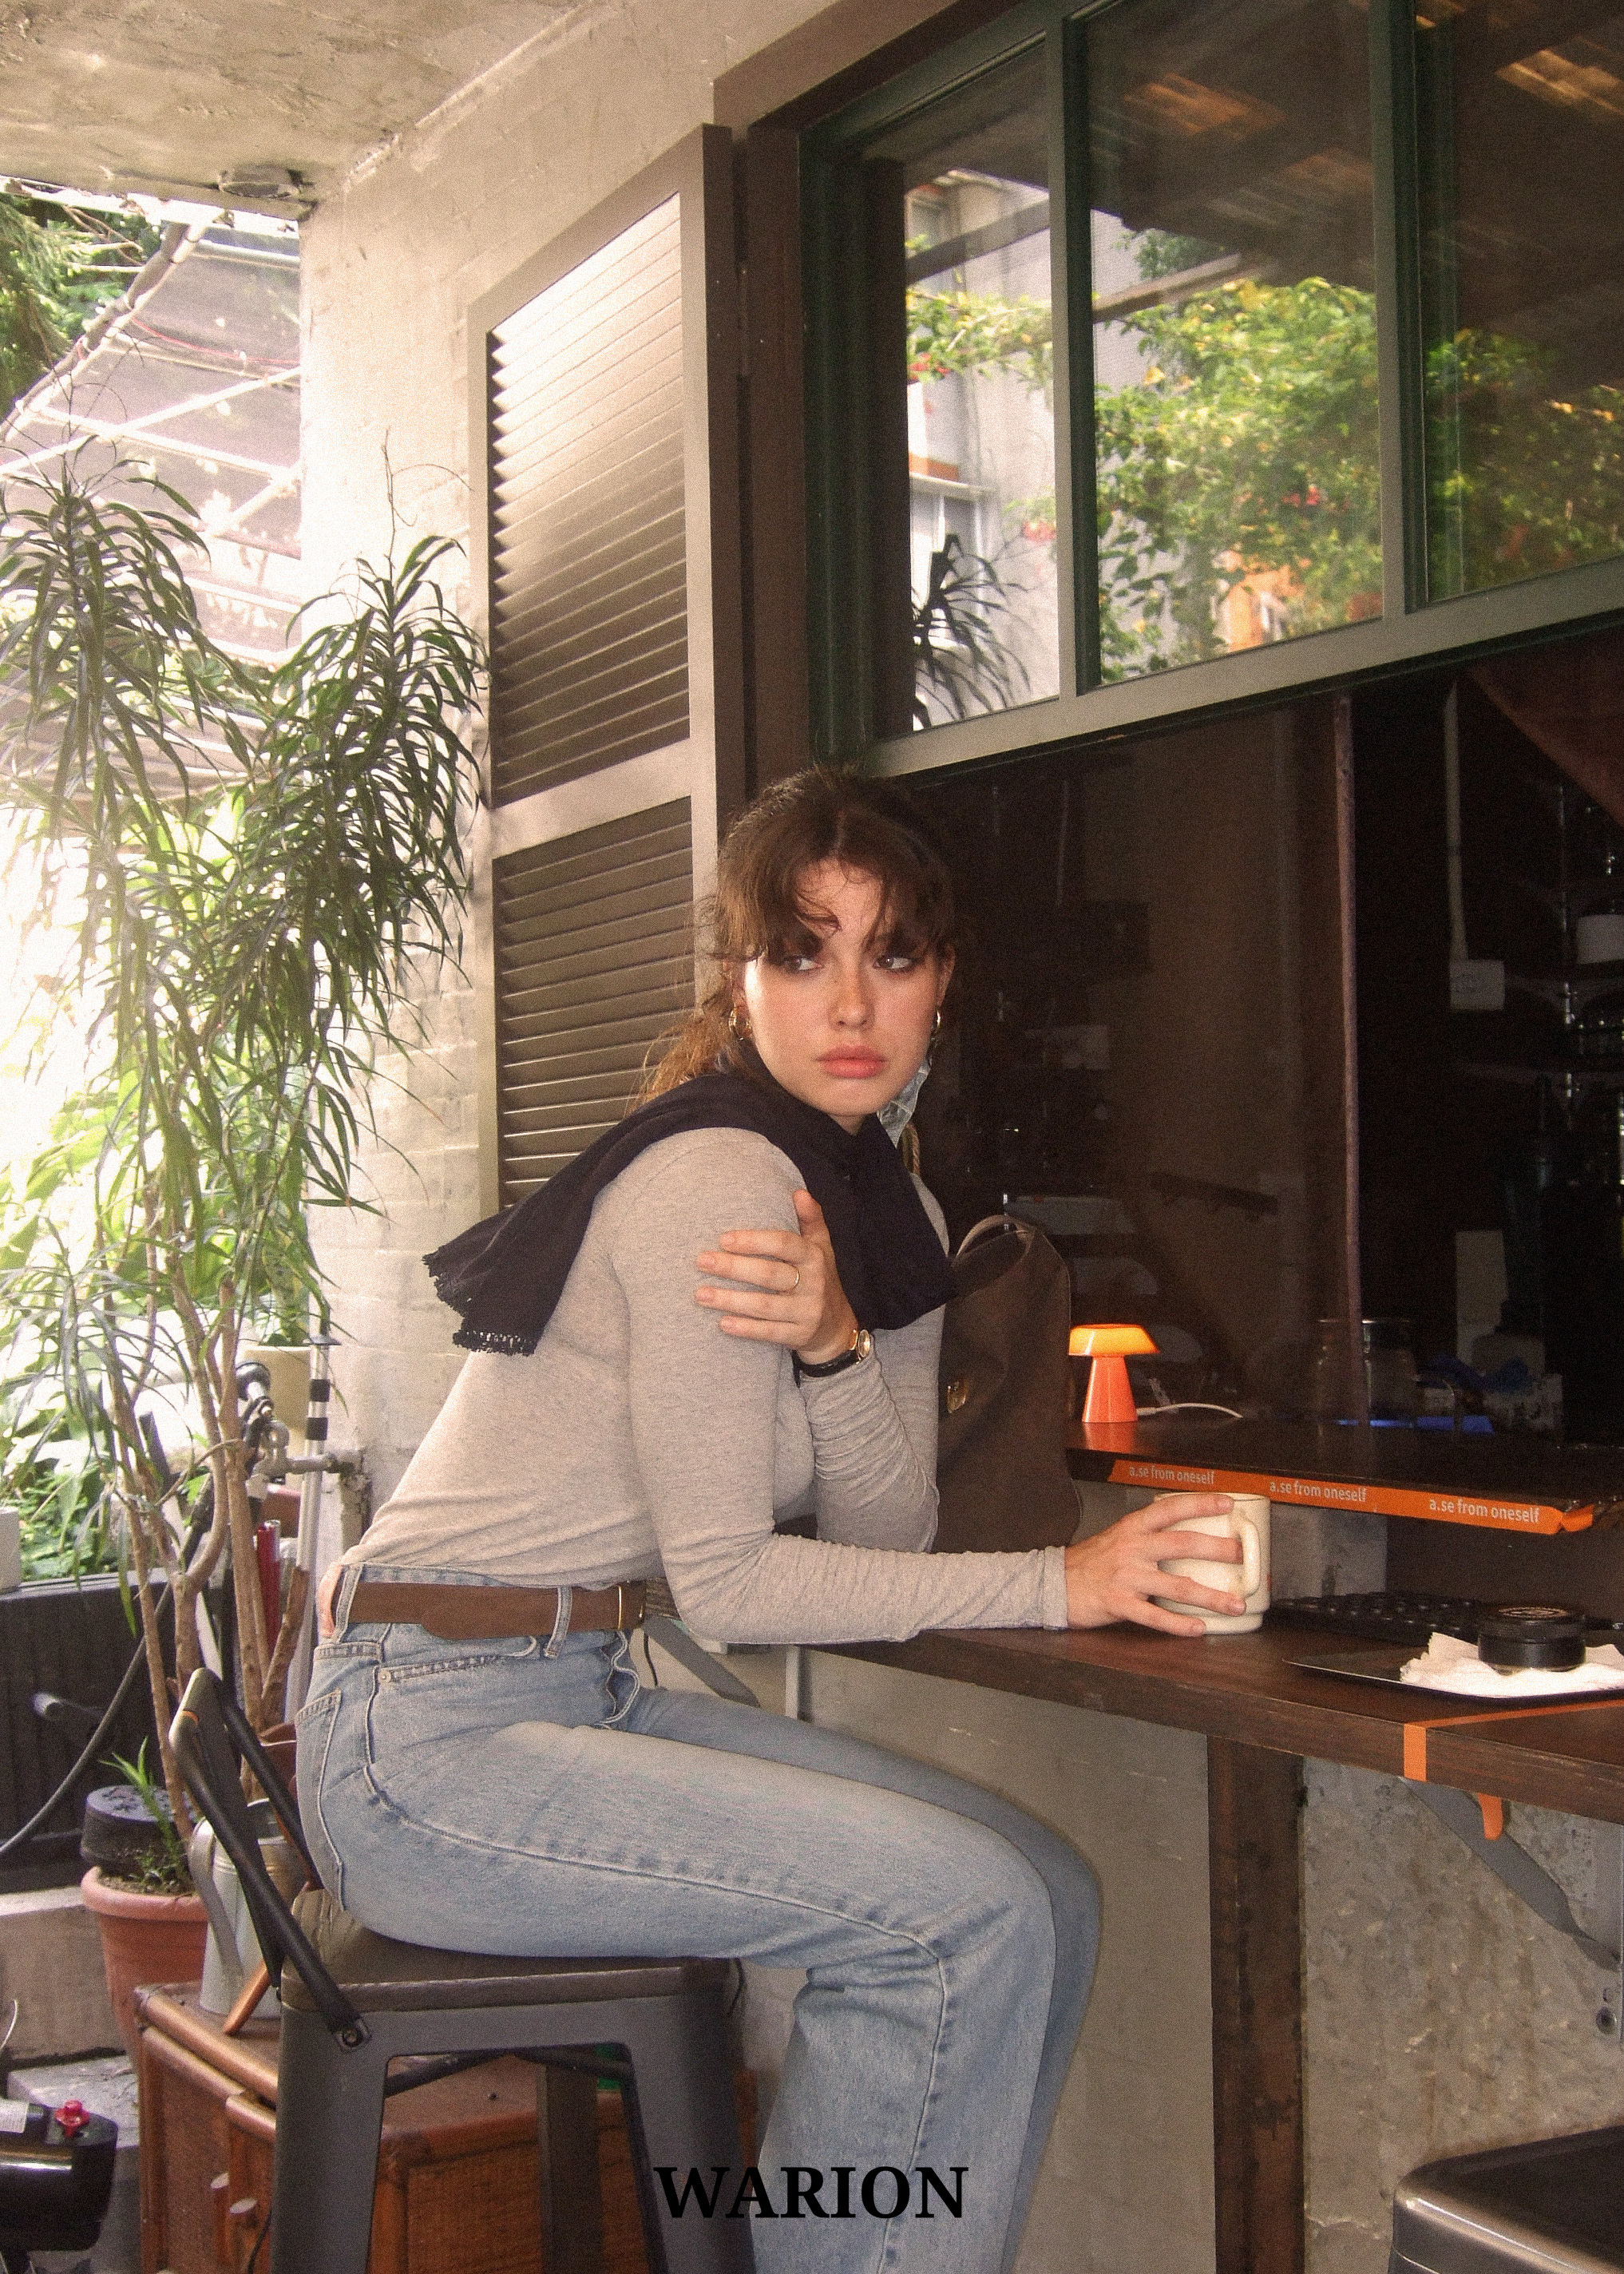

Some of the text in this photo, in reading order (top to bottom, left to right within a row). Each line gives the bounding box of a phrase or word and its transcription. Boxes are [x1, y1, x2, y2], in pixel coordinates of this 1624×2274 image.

[1129, 1465, 1214, 1485] a.se from oneself
[1269, 1480, 1367, 1502] a.se from oneself
[1429, 1498, 1539, 1523] a.se from oneself
